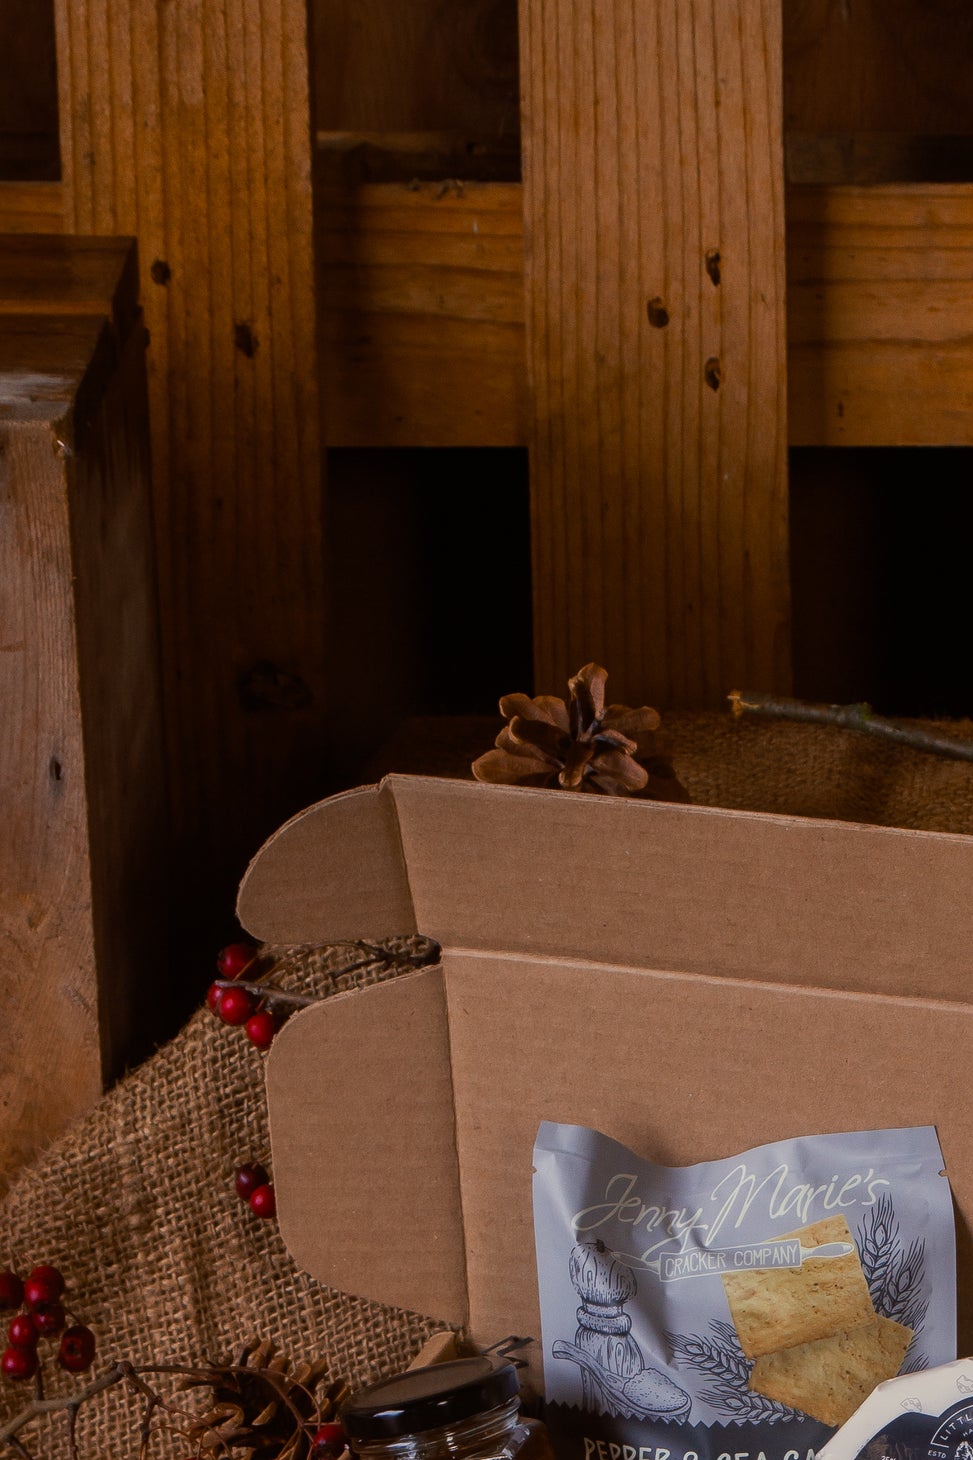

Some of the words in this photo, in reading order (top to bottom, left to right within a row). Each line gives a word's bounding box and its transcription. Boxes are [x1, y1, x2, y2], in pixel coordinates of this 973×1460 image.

[571, 1173, 709, 1260] Jenny
[706, 1163, 891, 1246] Marie's
[665, 1250, 727, 1279] CRACKER
[733, 1243, 800, 1268] COMPANY
[927, 1449, 947, 1460] ESTD
